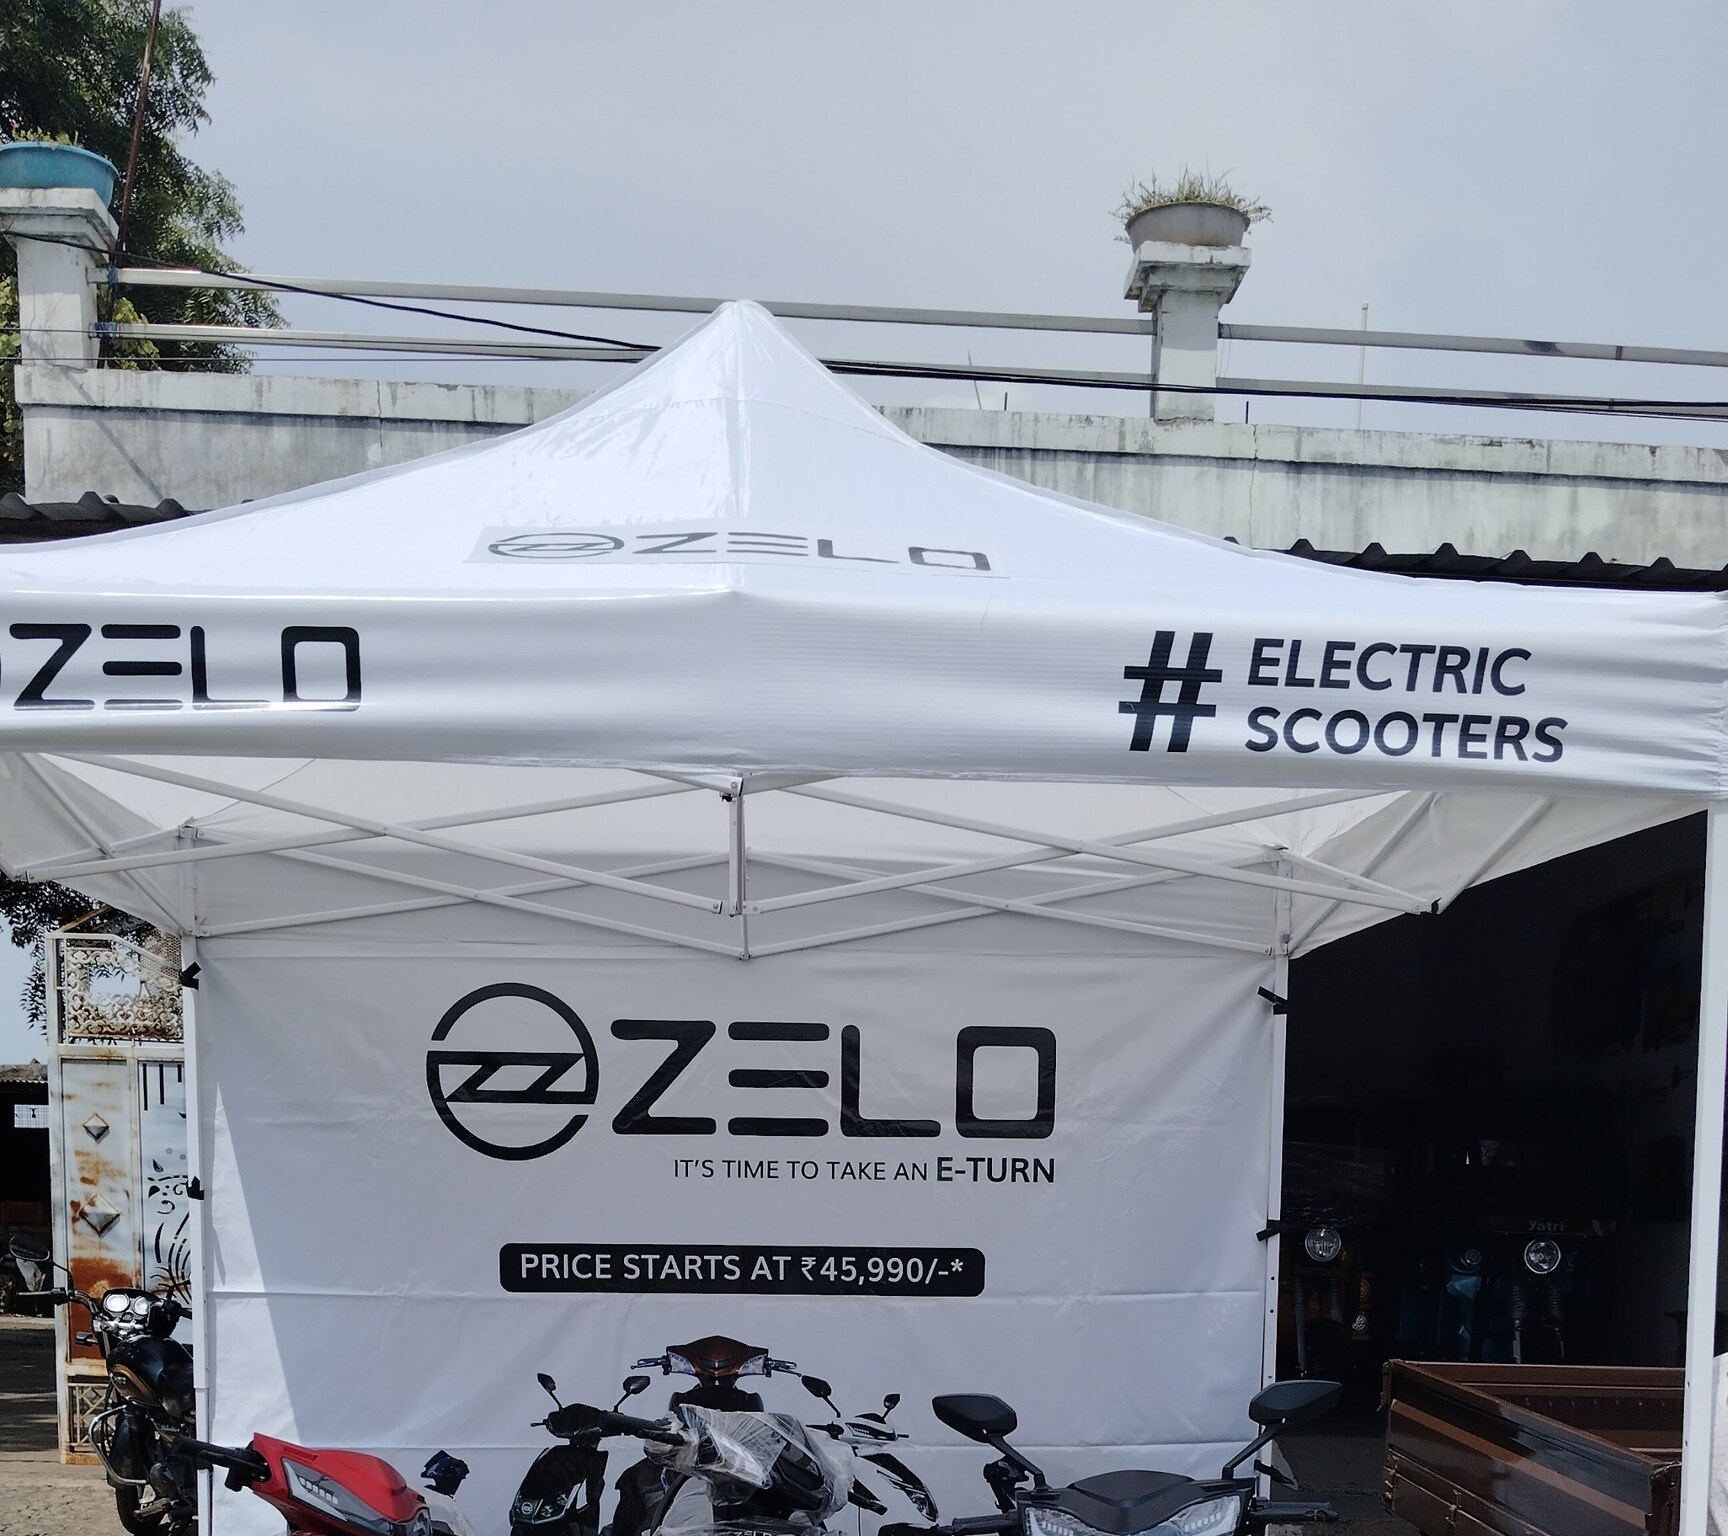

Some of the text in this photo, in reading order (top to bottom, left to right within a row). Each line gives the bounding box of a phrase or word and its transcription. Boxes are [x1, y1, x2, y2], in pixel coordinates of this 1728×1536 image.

[632, 531, 992, 571] ZELO
[8, 623, 362, 712] ZELO
[1247, 637, 1532, 696] ELECTRIC
[1244, 706, 1569, 763] SCOOTERS
[610, 1018, 1056, 1139] ZELO
[673, 1156, 1055, 1184] IT'S TIME TO TAKE AN E-TURN
[520, 1253, 612, 1280] PRICE
[623, 1254, 741, 1281] STARTS
[751, 1256, 791, 1281] AT
